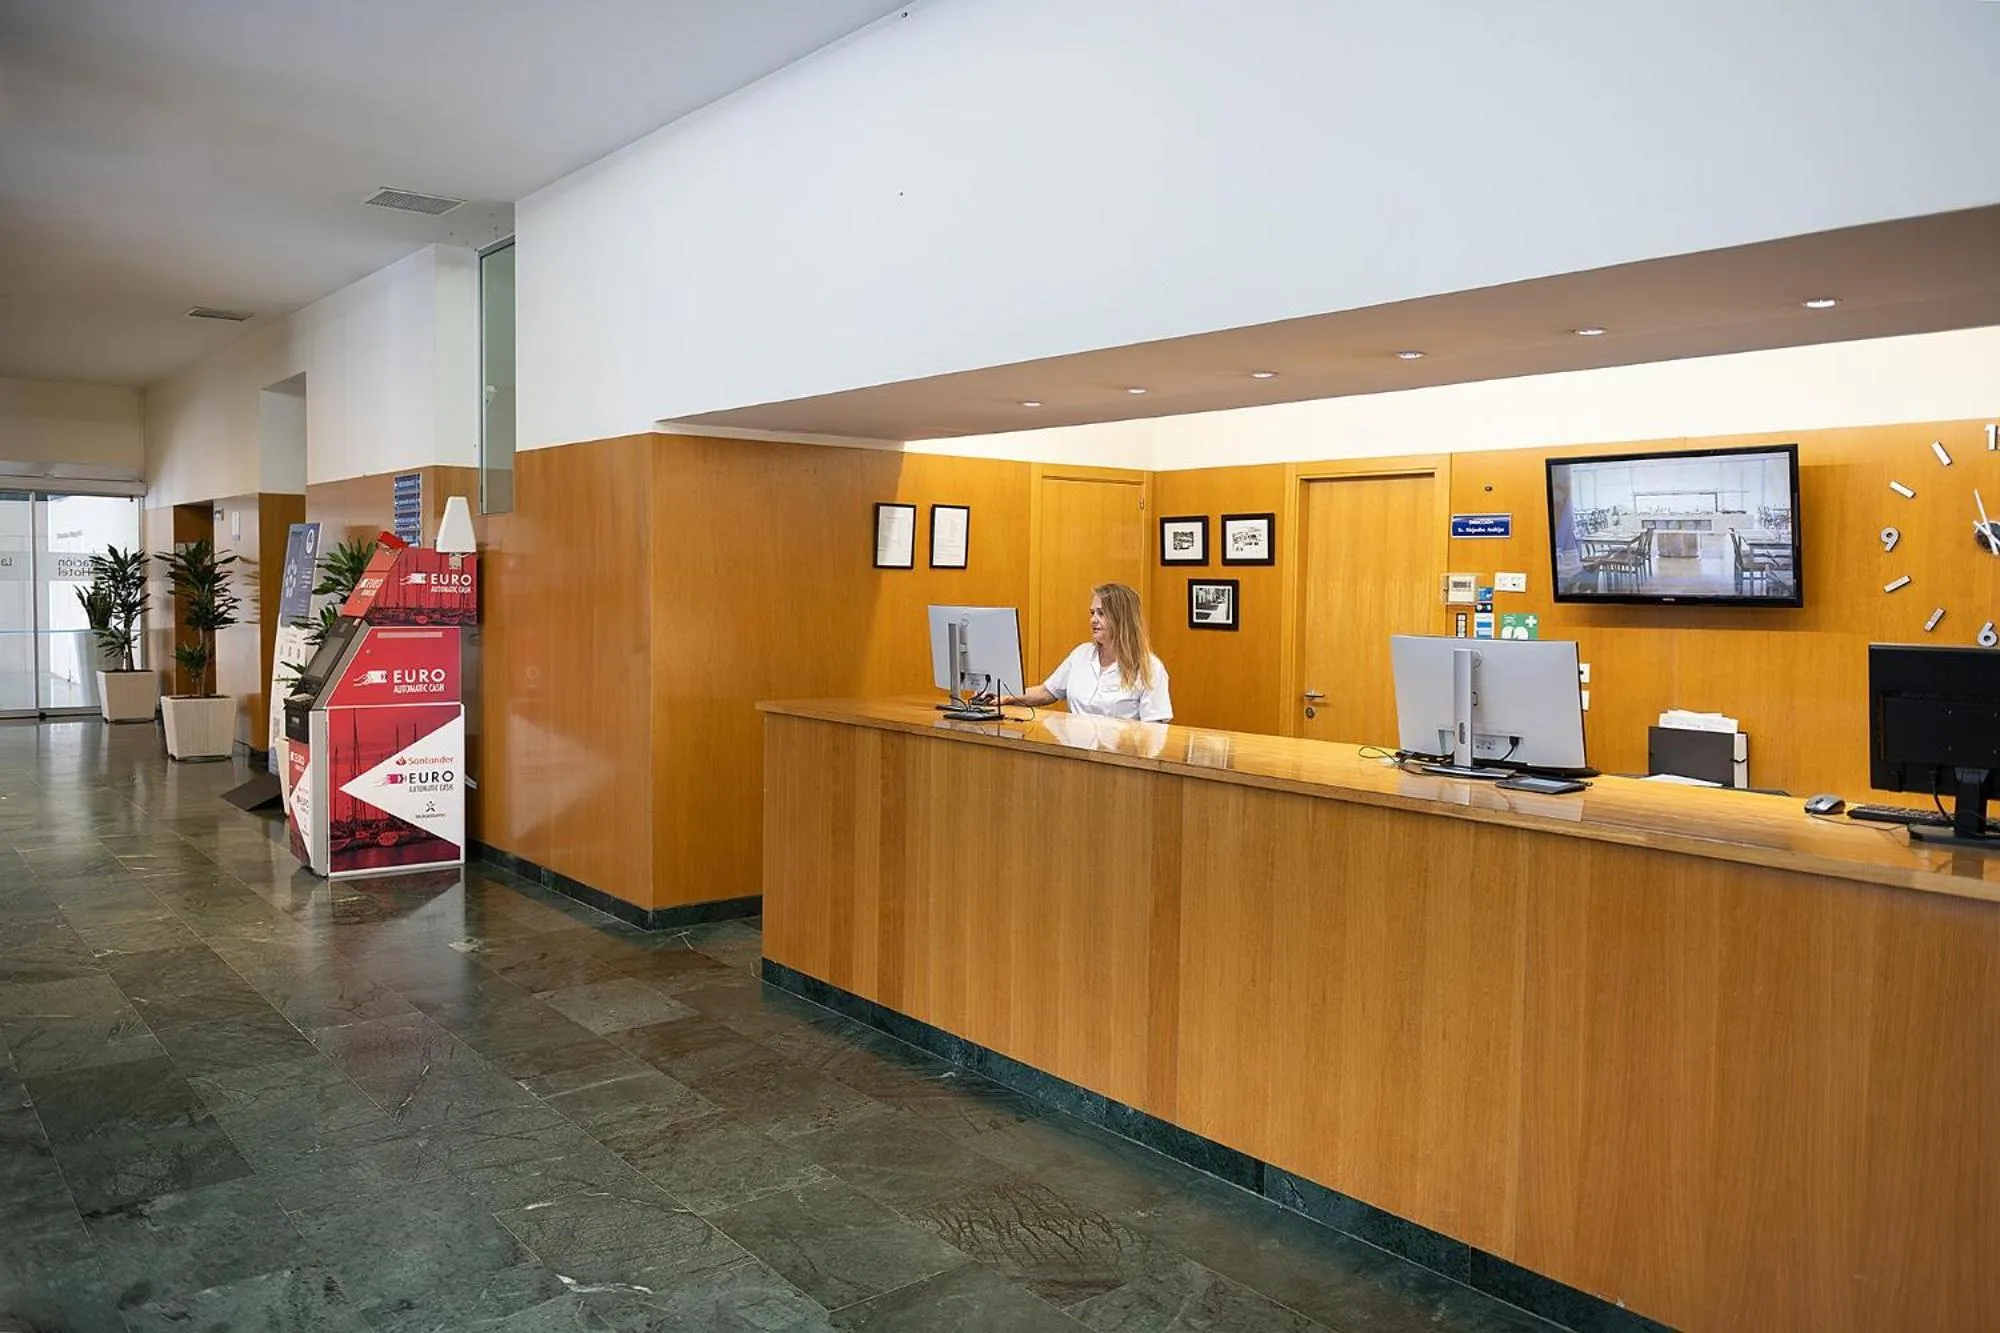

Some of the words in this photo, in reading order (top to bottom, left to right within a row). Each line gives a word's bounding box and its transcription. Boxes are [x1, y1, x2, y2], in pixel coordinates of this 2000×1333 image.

[1880, 527, 1900, 552] 9
[430, 573, 472, 586] EURO
[1977, 621, 1998, 647] 6
[392, 668, 446, 683] EURO
[393, 684, 428, 694] AUTOMATIC
[428, 683, 445, 692] CASH
[408, 756, 455, 766] Santander
[408, 769, 455, 784] EURO
